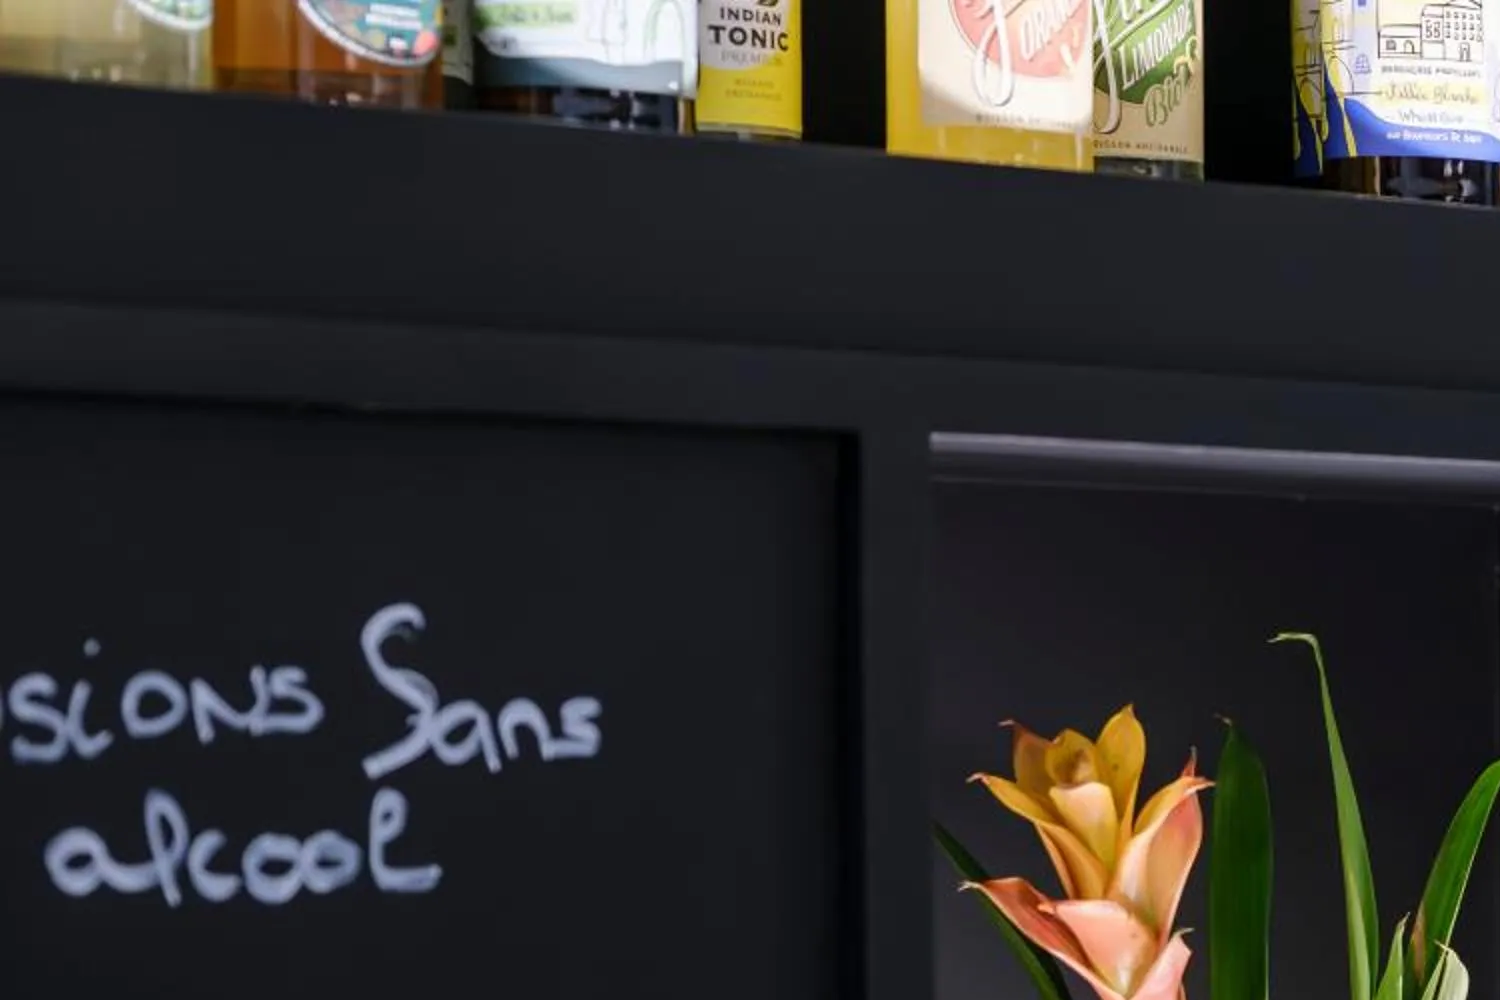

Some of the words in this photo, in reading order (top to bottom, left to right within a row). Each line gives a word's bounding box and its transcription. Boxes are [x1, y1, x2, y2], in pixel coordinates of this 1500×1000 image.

[707, 24, 789, 52] TONIC
[719, 7, 782, 26] INDIAN
[0, 636, 325, 763] sions
[360, 601, 602, 780] Sans
[43, 787, 443, 907] alcool
